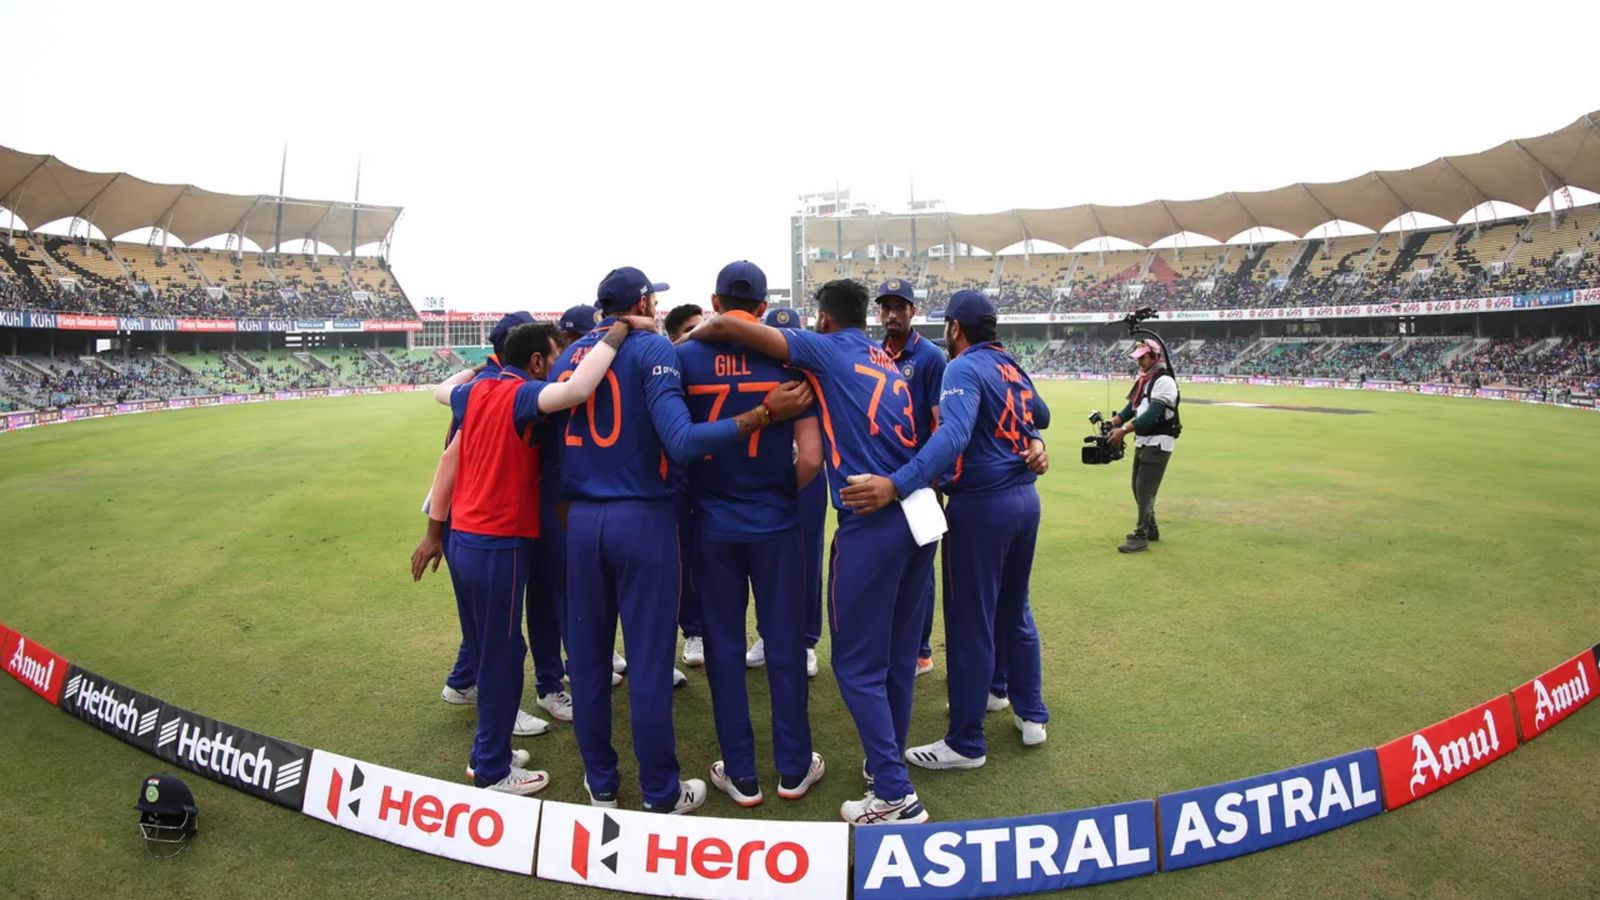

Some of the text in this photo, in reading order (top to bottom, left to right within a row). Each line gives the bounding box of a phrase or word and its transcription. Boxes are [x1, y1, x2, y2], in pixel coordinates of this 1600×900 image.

[714, 353, 752, 377] GILL
[688, 381, 780, 459] 77
[854, 363, 918, 448] 73
[9, 637, 55, 692] Amul
[1533, 660, 1590, 731] Amul
[76, 678, 139, 734] Hettich
[177, 723, 273, 790] Hettich
[1410, 709, 1500, 797] Amul
[378, 785, 505, 847] Hero
[684, 791, 695, 803] N
[1170, 761, 1377, 857] ASTRAL
[645, 833, 810, 884] Hero
[863, 813, 1150, 890] ASTRAL
